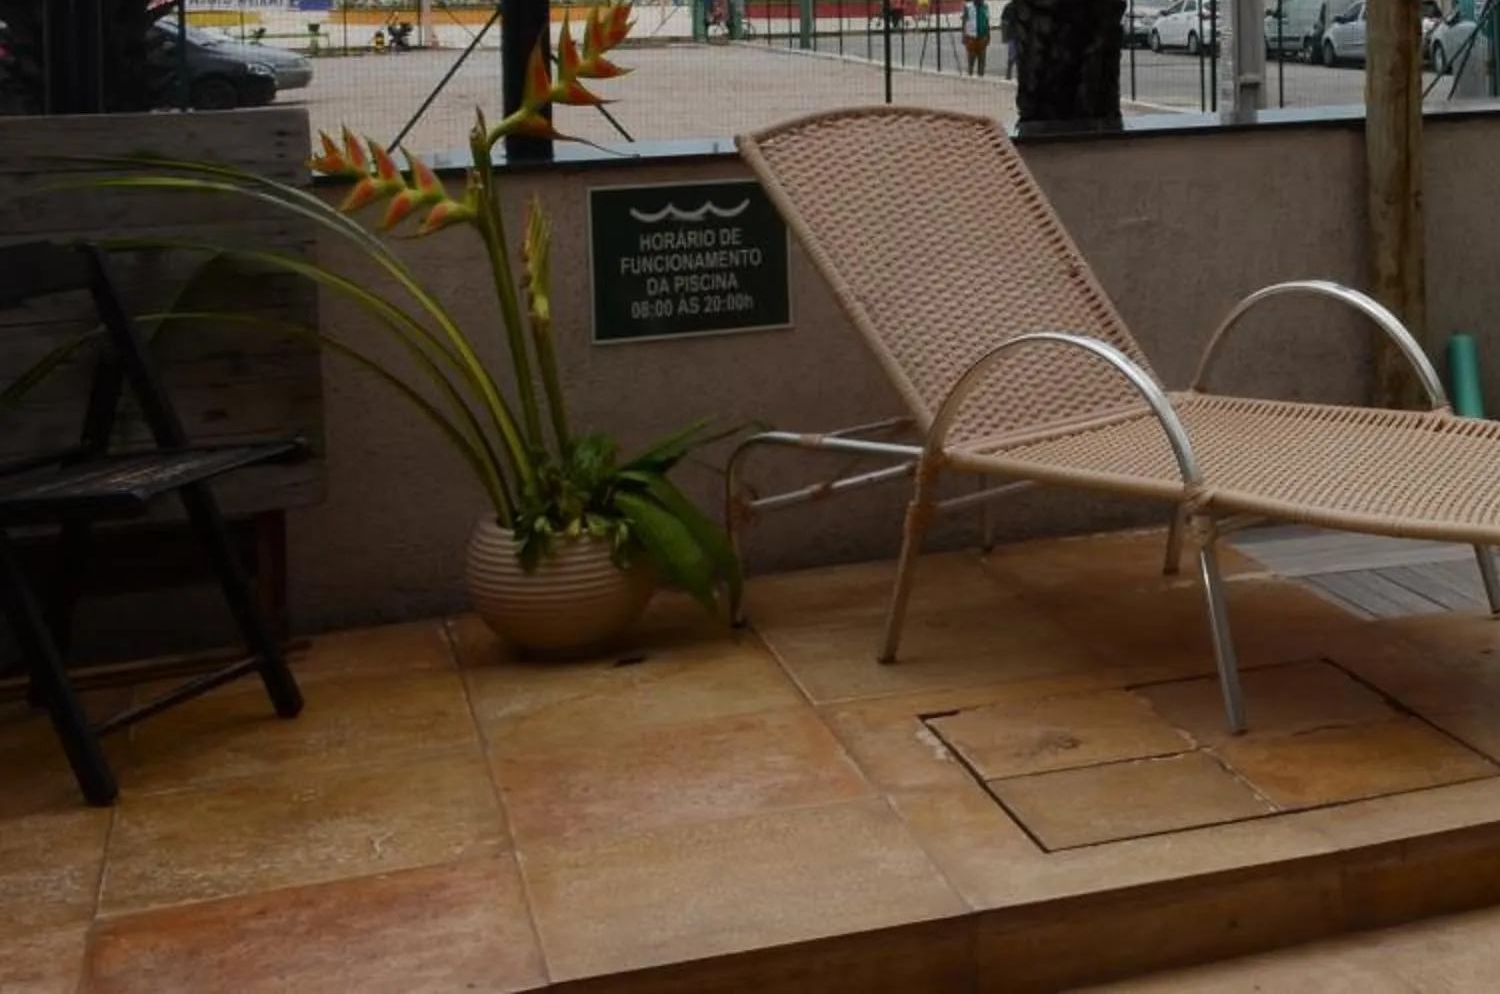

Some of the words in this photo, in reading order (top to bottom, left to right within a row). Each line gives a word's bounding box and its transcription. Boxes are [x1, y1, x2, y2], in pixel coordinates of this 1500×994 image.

[719, 227, 743, 246] DE
[620, 248, 763, 275] FUNCIONAMENTO
[646, 277, 670, 296] DA
[673, 273, 738, 293] PISCINA
